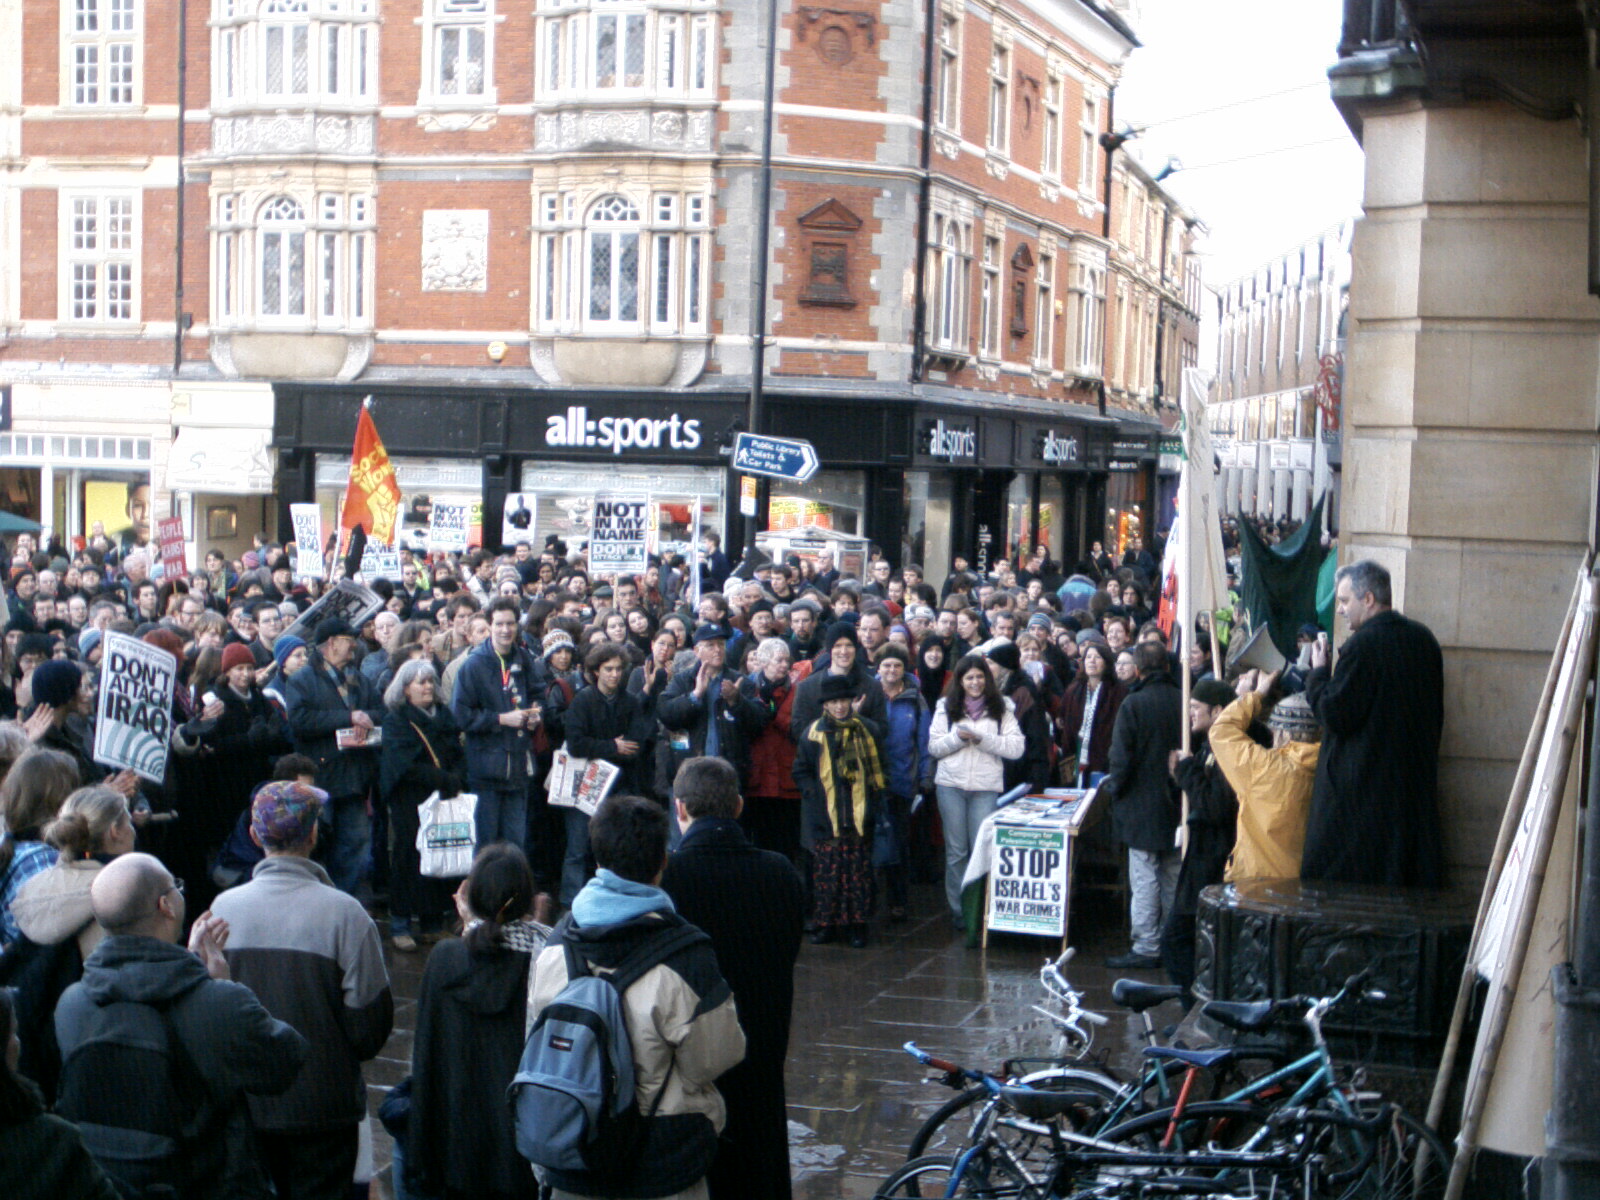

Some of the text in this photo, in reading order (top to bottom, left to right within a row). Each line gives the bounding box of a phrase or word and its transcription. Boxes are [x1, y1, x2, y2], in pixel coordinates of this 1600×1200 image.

[544, 405, 702, 456] all:sports
[749, 448, 787, 462] Toilets &
[751, 439, 802, 457] Public Library
[748, 457, 783, 472] Car Park
[434, 504, 467, 516] NOT
[595, 502, 646, 518] NOT
[432, 520, 466, 530] NAME
[447, 514, 466, 523] MY
[594, 517, 644, 529] IN MY
[593, 529, 645, 541] NAME
[110, 651, 171, 693] DON'T
[109, 672, 169, 711] ATTACK
[105, 690, 168, 744] IRAQ
[1008, 829, 1043, 839] Campaign
[1000, 837, 1061, 848] Palestinian Rights
[998, 846, 1061, 879] STOP
[994, 879, 1062, 903] ISRAEL'S
[995, 902, 1062, 919] WAR CRIMES
